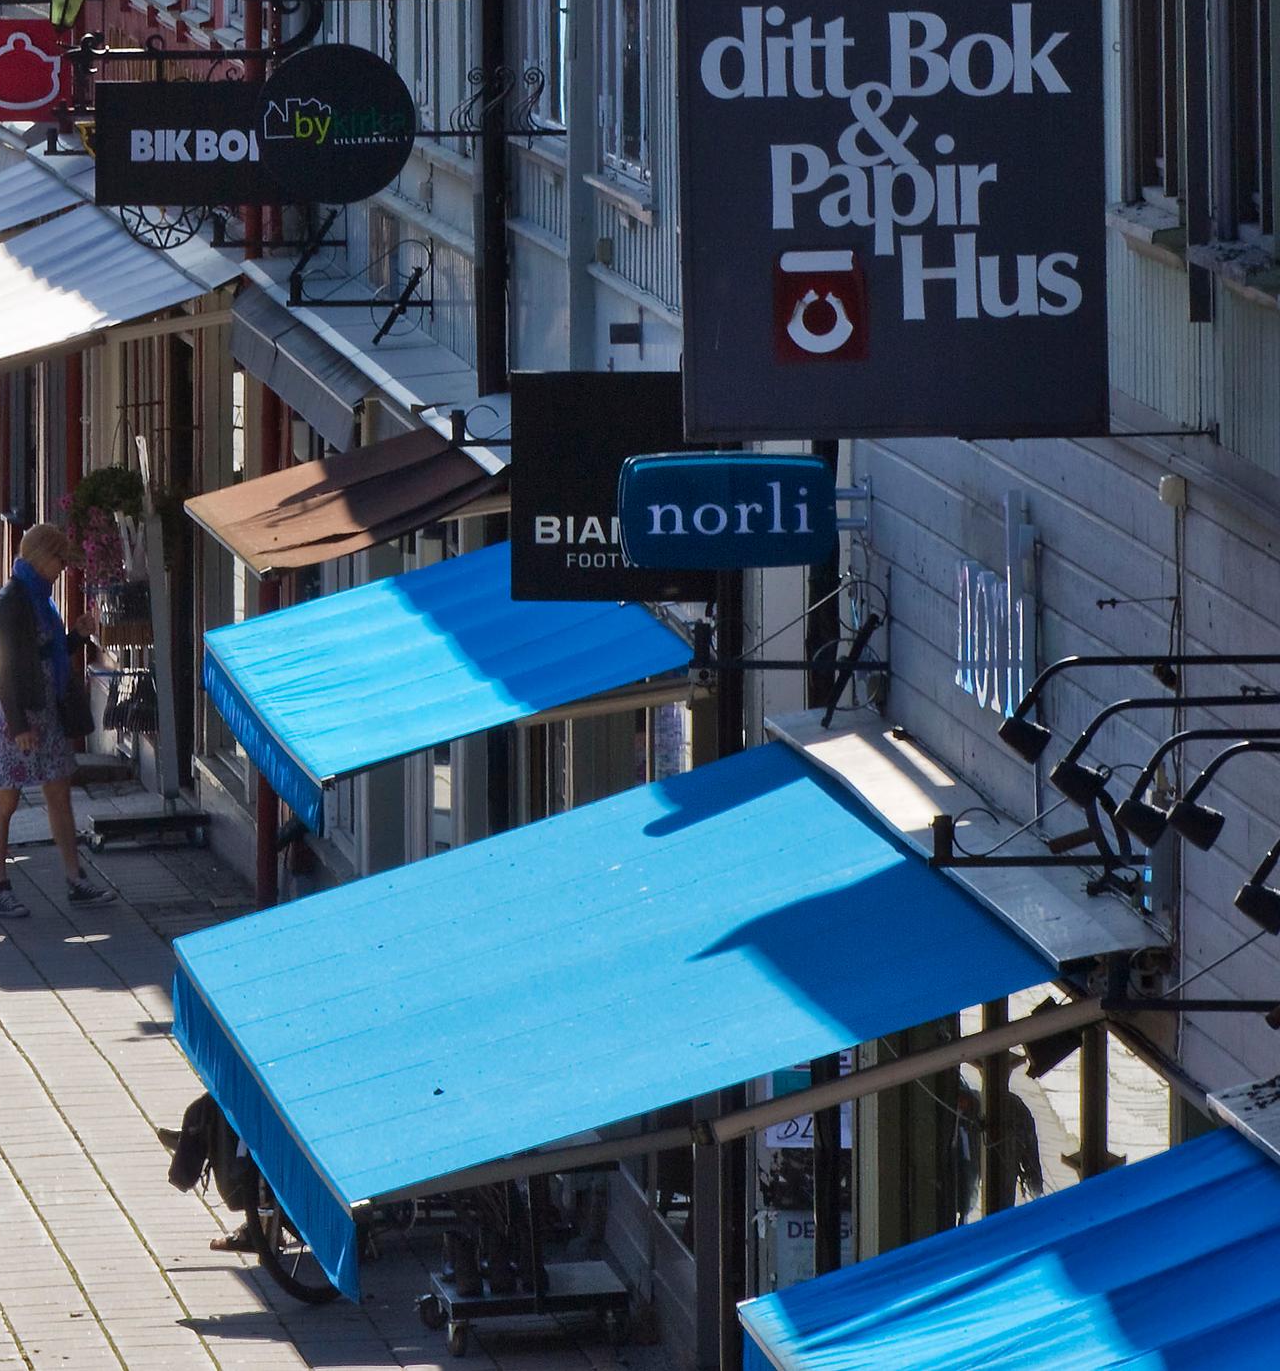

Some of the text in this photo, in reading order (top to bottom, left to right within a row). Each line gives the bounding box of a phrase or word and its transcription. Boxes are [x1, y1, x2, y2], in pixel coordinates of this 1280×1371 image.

[700, 3, 1072, 99] ditt Bok
[131, 130, 192, 162] BIK
[837, 81, 919, 168] &
[770, 134, 998, 256] Papir
[900, 232, 1083, 321] Hus
[647, 481, 814, 536] norli
